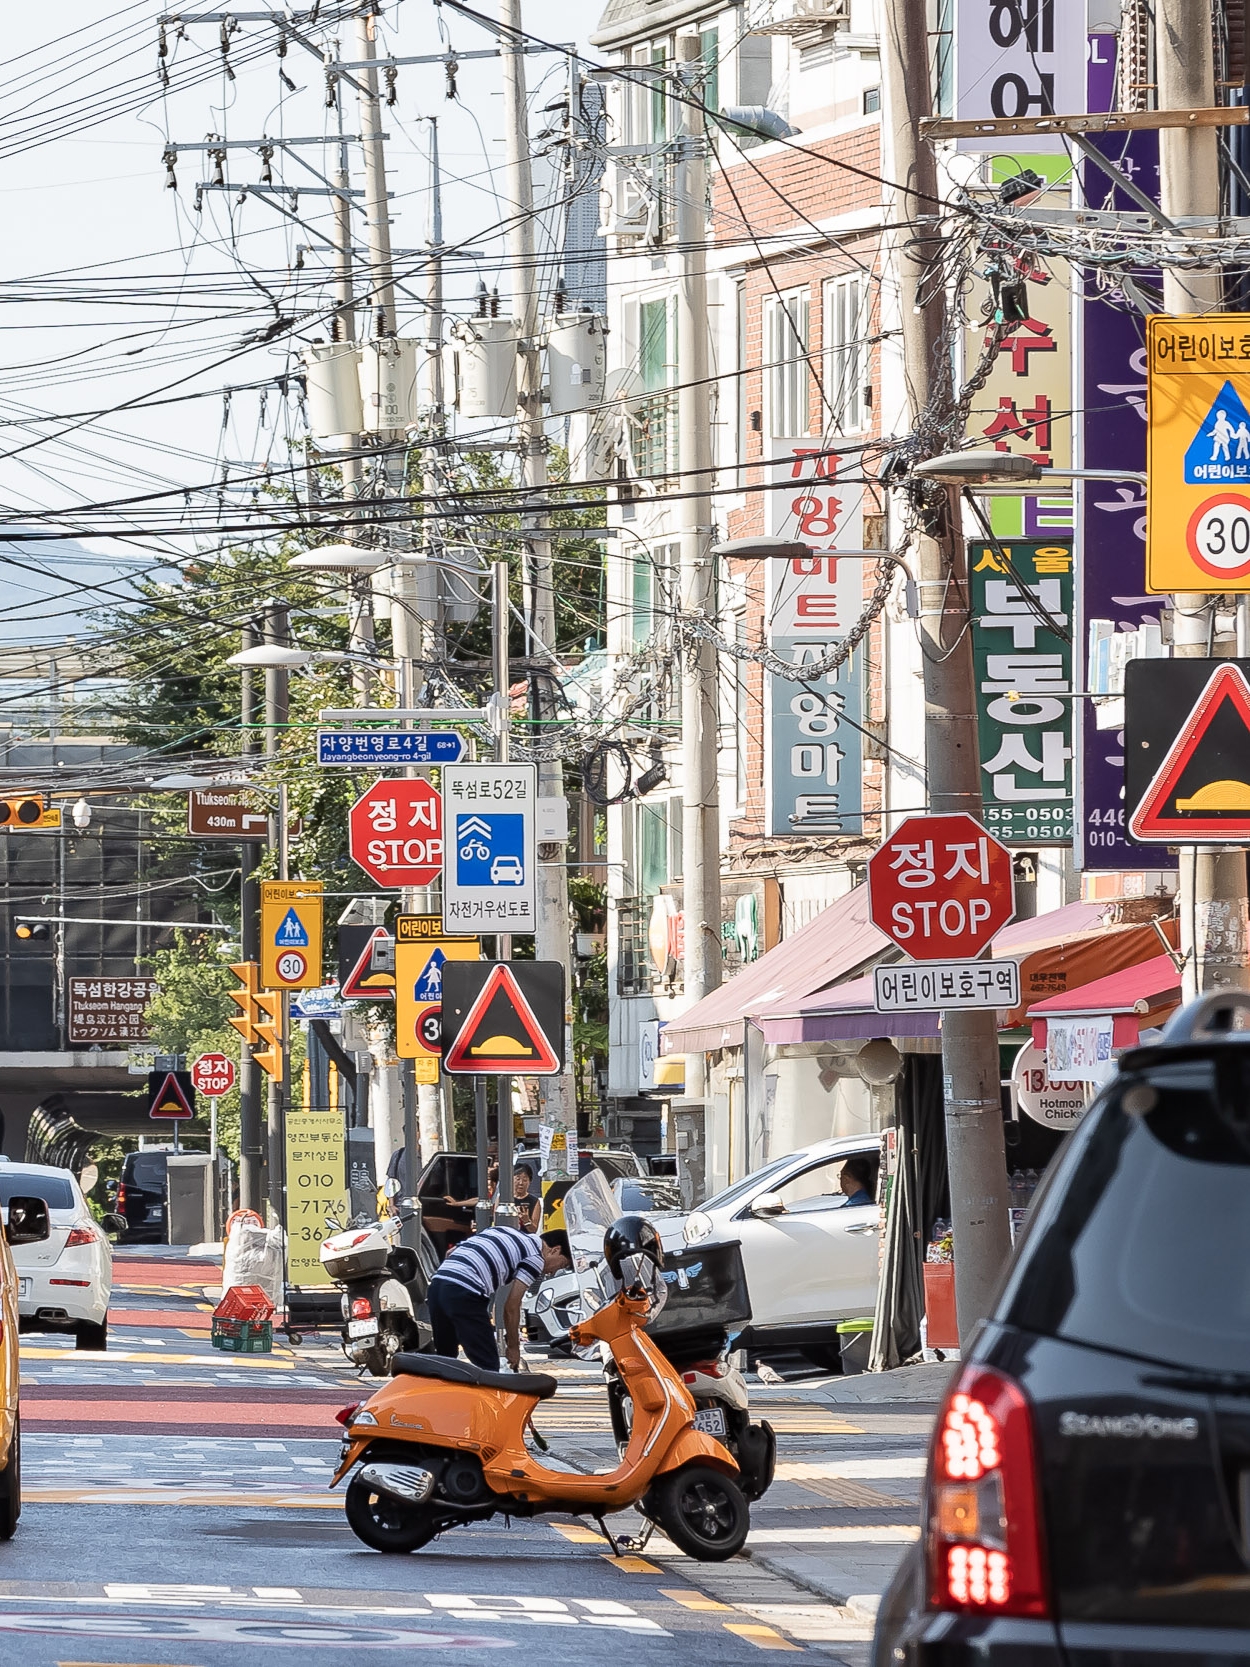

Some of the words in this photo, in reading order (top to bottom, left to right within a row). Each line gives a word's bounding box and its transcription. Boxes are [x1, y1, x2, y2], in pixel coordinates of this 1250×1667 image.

[1193, 464, 1250, 479] 어린이보
[791, 447, 843, 628] 자양마트
[1206, 517, 1250, 554] 30
[980, 578, 1072, 800] 부동산
[322, 736, 428, 752] 자양번영로4길
[790, 641, 846, 832] 자양마트
[322, 752, 411, 761] Jayangbeonyeong-ro
[412, 752, 432, 760] 4-gil
[451, 779, 527, 800] 뚝섬로52길
[196, 791, 236, 806] Ttukseom
[207, 816, 236, 827] 430m
[367, 797, 438, 832] 정지
[982, 808, 1074, 821] 55-0503
[367, 838, 444, 865] STOP
[888, 836, 990, 889] 정지
[449, 900, 530, 919] 자전거우선도로
[891, 898, 991, 939] STOP
[282, 959, 300, 974] 30
[882, 968, 1013, 1004] 어린이보호구역
[424, 1018, 442, 1041] 3
[197, 1059, 229, 1075] 정지
[197, 1077, 229, 1090] STOP
[287, 1133, 344, 1143] 영진부동산
[292, 1151, 339, 1162] 문자상담
[297, 1174, 333, 1187] 010
